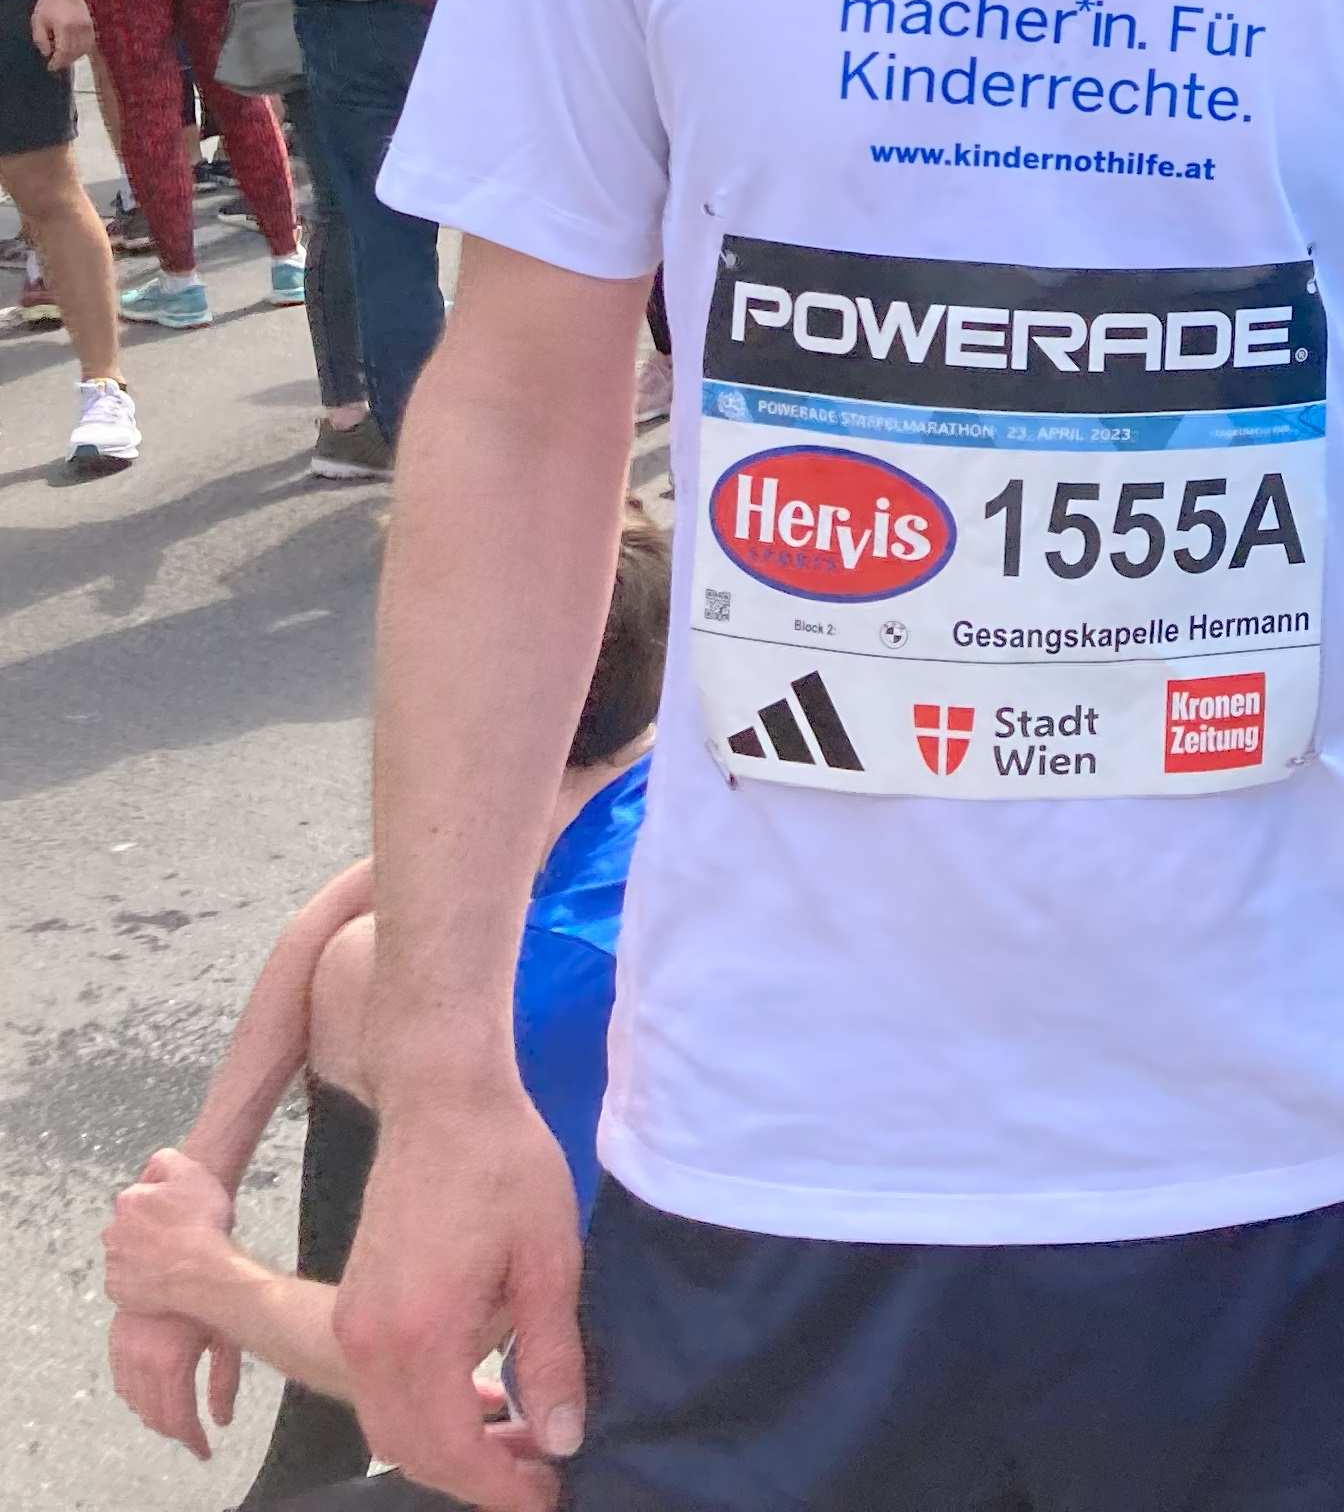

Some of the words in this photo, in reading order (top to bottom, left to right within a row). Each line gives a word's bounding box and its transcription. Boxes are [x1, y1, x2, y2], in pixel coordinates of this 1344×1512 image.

[1169, 4, 1267, 59] Für
[839, 50, 1253, 123] Kinderrechte.
[870, 142, 1217, 181] www.kindernothilfe.at
[730, 280, 1295, 374] POWERADE
[757, 399, 838, 423] POWERADE
[1037, 426, 1085, 442] APRIL
[1090, 426, 1131, 442] 2023
[734, 472, 932, 570] Hervis
[983, 471, 1307, 580] 1555A
[793, 619, 825, 634] Block
[951, 616, 1180, 654] Gesangskapelle
[1189, 609, 1310, 641] Hermann
[993, 704, 1100, 738] Stadt
[1170, 687, 1262, 722] Kronen
[993, 744, 1098, 777] Wien
[1170, 721, 1261, 758] Zeitung
